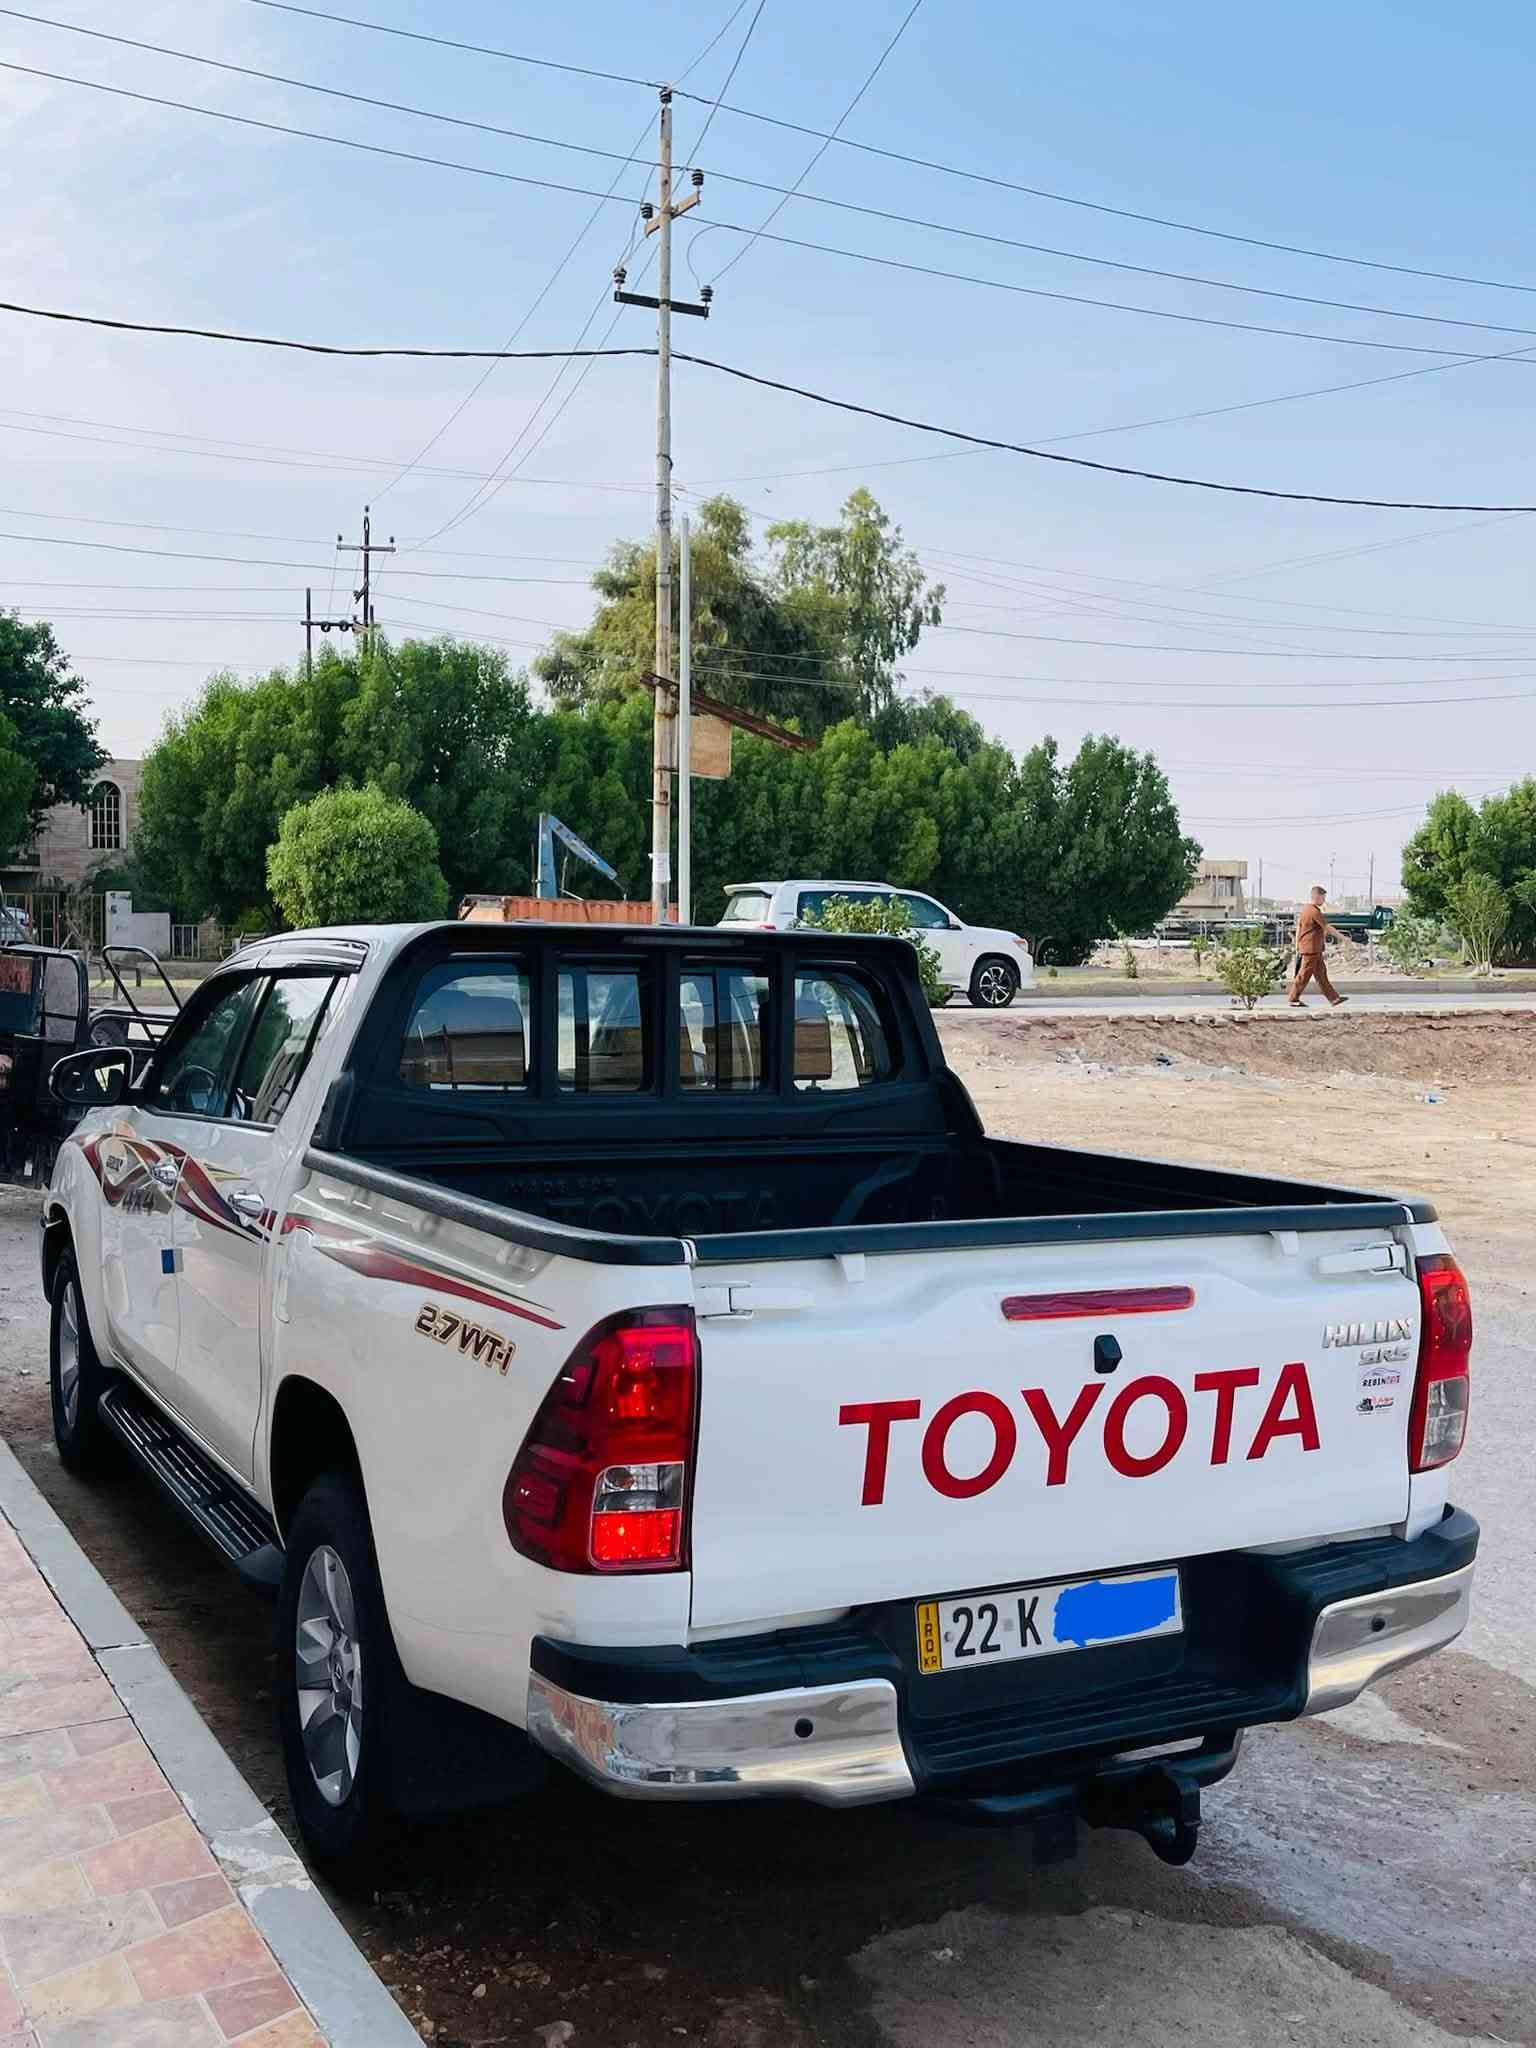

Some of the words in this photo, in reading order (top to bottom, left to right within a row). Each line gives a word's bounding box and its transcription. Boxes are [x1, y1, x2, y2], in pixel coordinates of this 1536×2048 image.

[1321, 1319, 1412, 1349] HILUX
[838, 1362, 1321, 1506] TOYOTA
[952, 1603, 1001, 1658] 22
[1016, 1596, 1043, 1648] K
